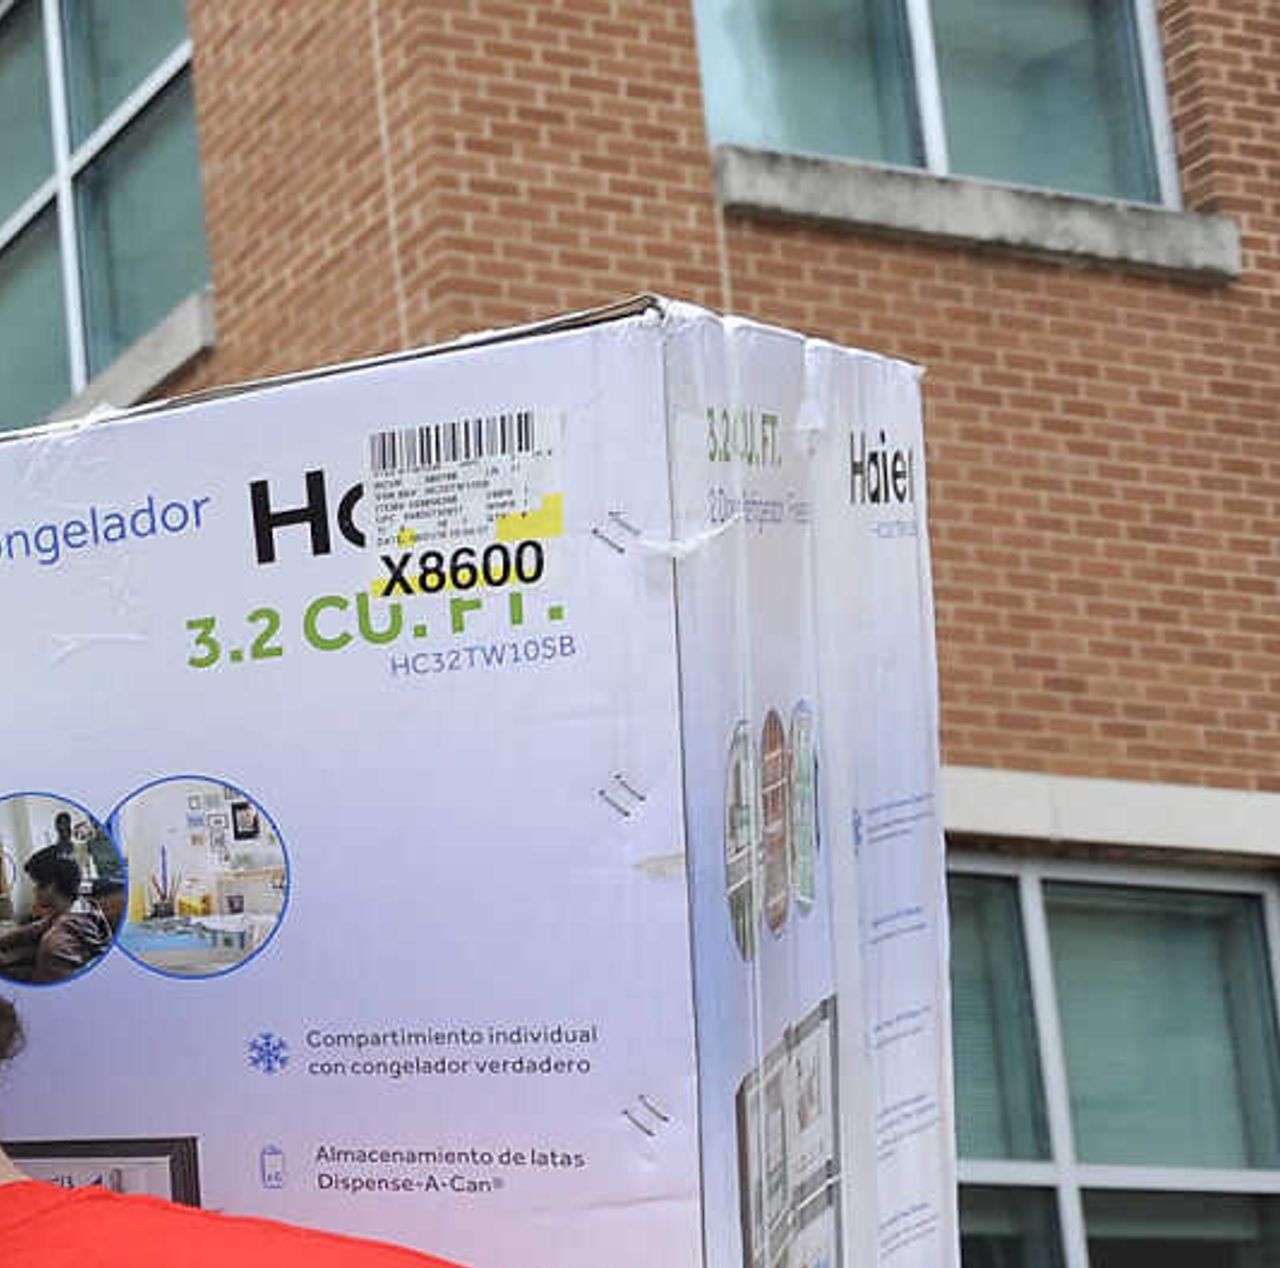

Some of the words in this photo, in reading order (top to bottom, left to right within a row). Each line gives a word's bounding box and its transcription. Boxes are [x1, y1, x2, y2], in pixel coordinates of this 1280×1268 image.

[380, 540, 545, 596] X8600
[185, 608, 284, 669] 3.2
[303, 590, 428, 652] CU.
[391, 635, 576, 677] HC32TW10SB
[307, 1026, 483, 1053] Compartimiento
[489, 1024, 598, 1046] individual
[308, 1057, 346, 1076] con
[350, 1053, 468, 1078] congelador
[474, 1053, 591, 1075] verdadero
[315, 1145, 494, 1167] Almacenamiento
[498, 1146, 525, 1167] de
[531, 1147, 586, 1169] latas
